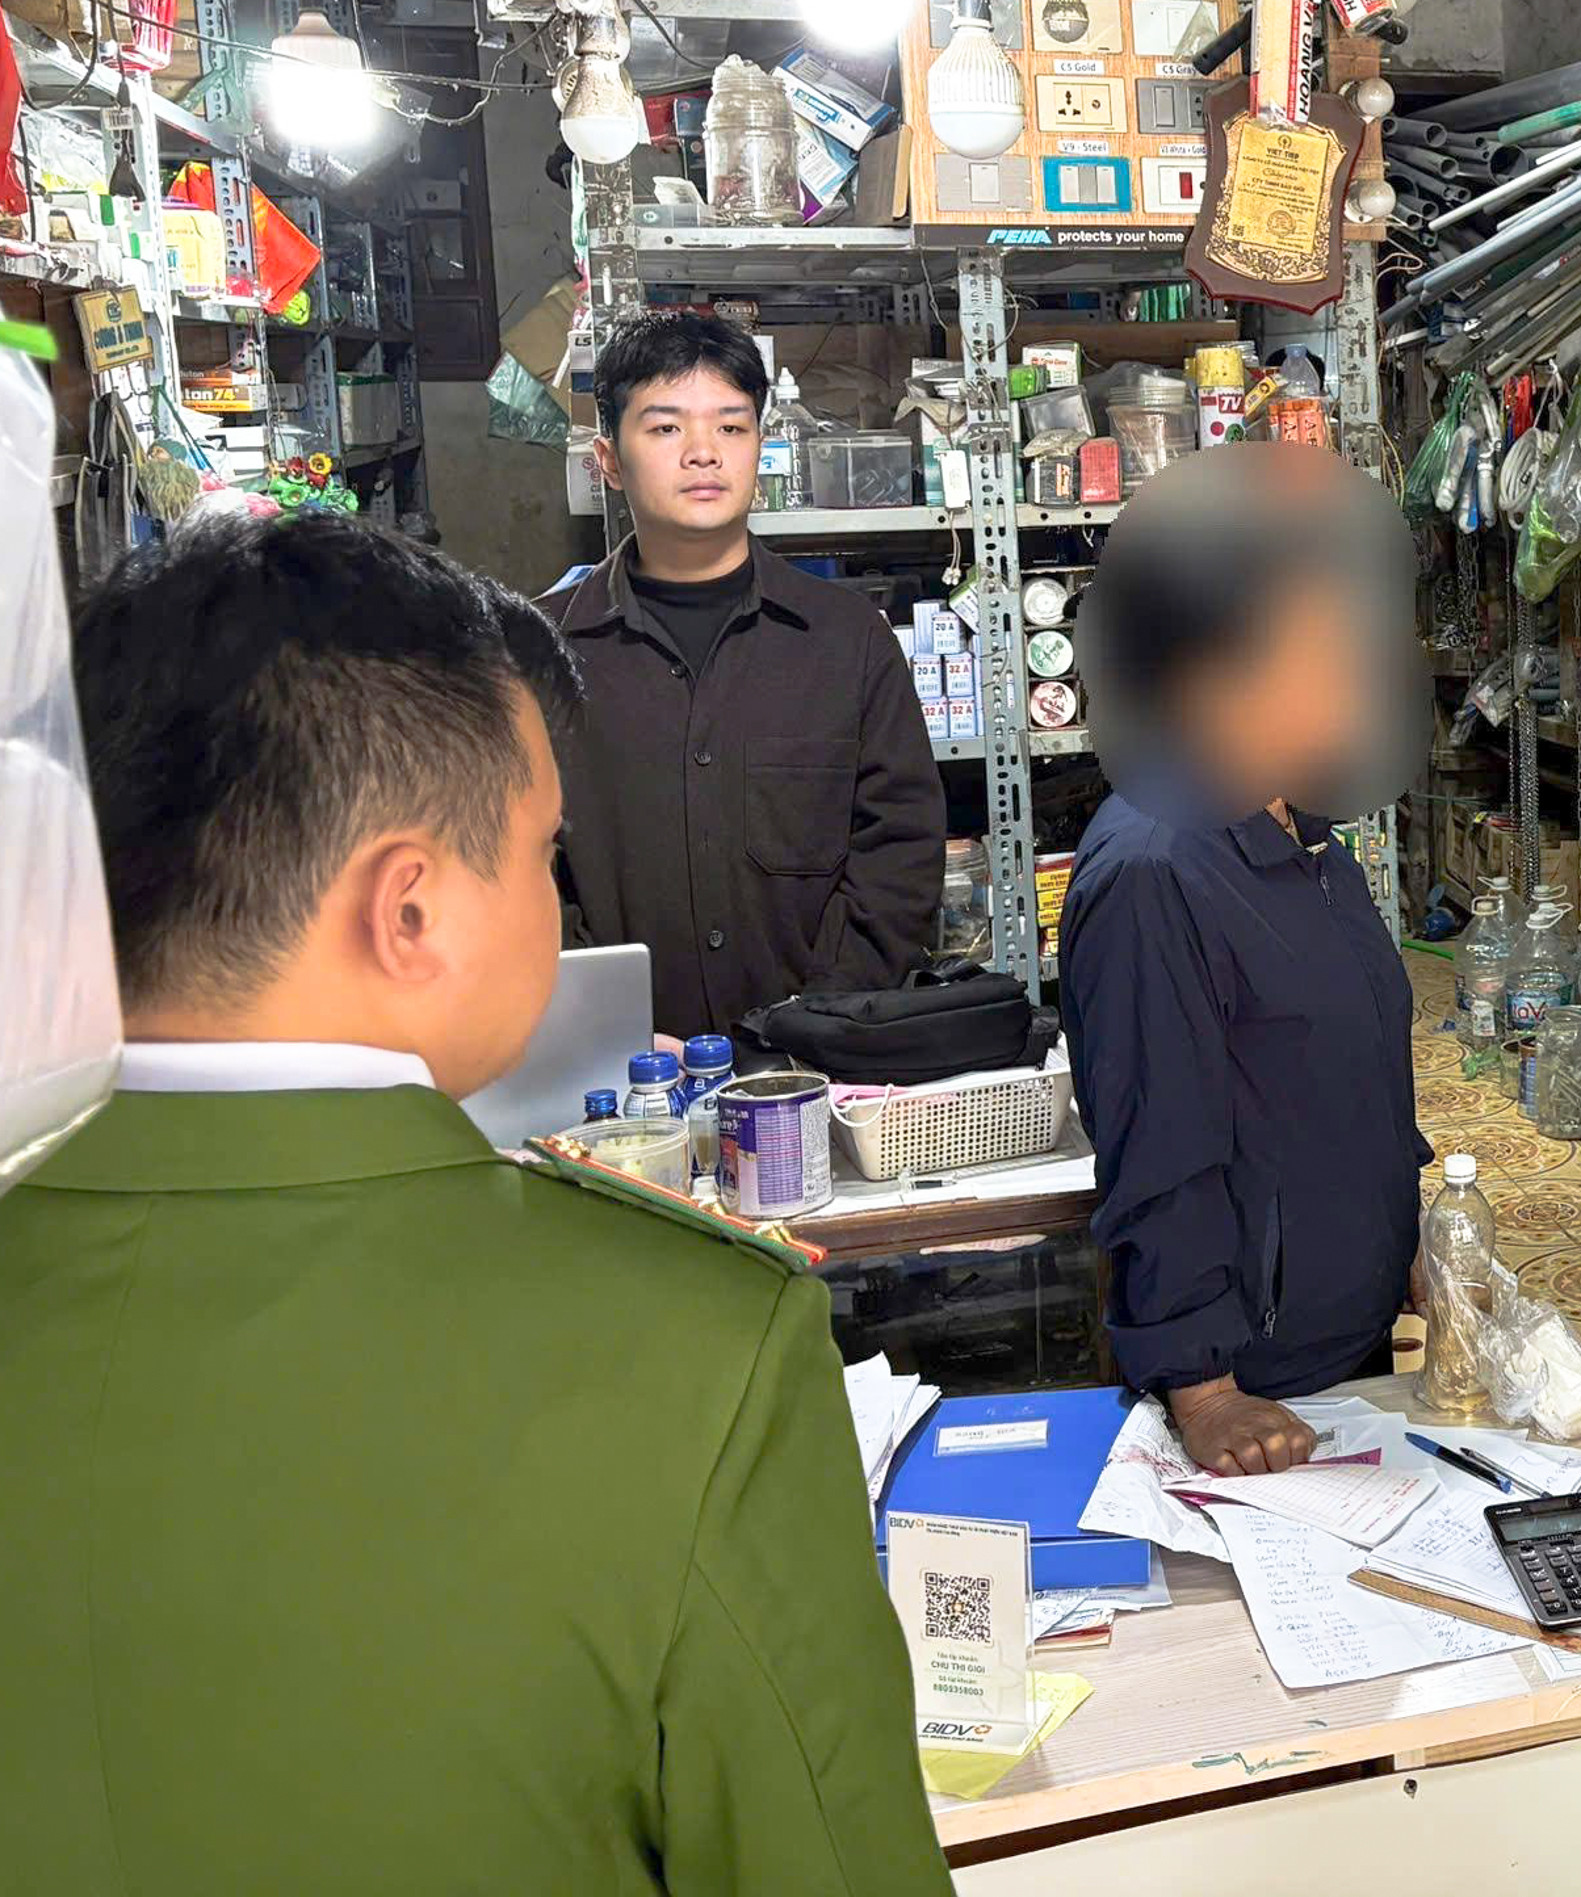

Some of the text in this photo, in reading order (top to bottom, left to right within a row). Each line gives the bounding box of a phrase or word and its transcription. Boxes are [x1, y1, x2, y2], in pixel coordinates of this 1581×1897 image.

[1074, 63, 1096, 72] Gold
[1082, 142, 1107, 151] Steel
[986, 228, 1185, 248] PEHA protects your home
[575, 336, 592, 346] LS
[1221, 396, 1241, 411] TV
[935, 623, 955, 631] 20 A
[917, 667, 937, 675] 20 A
[949, 665, 970, 673] 32 A
[924, 707, 945, 716] 32 A
[951, 705, 973, 715] 32 A
[889, 1516, 915, 1529] BIDV
[922, 1722, 975, 1736] BIDV
